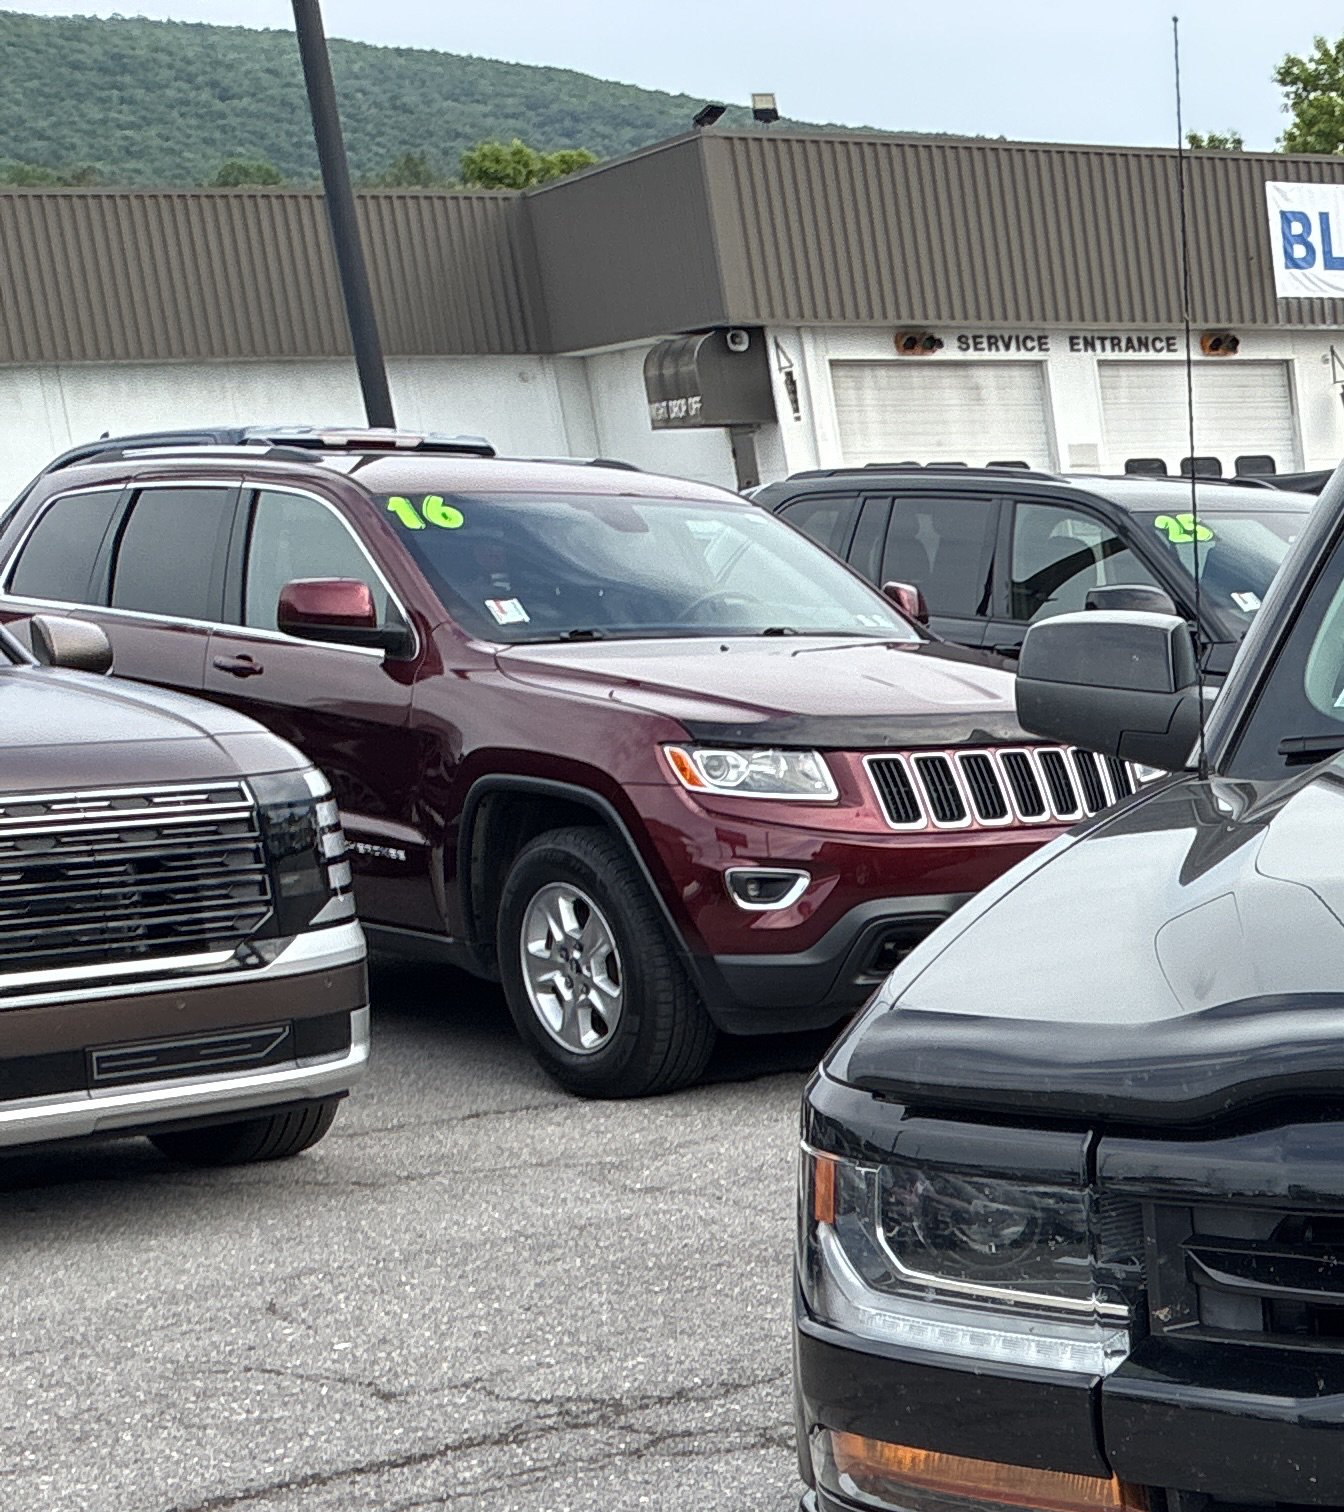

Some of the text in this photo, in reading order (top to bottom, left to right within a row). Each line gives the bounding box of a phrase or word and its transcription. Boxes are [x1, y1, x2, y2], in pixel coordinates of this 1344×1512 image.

[957, 334, 1179, 353] SERVICE ENTRANCE
[387, 494, 465, 530] 16
[1154, 513, 1214, 543] 25
